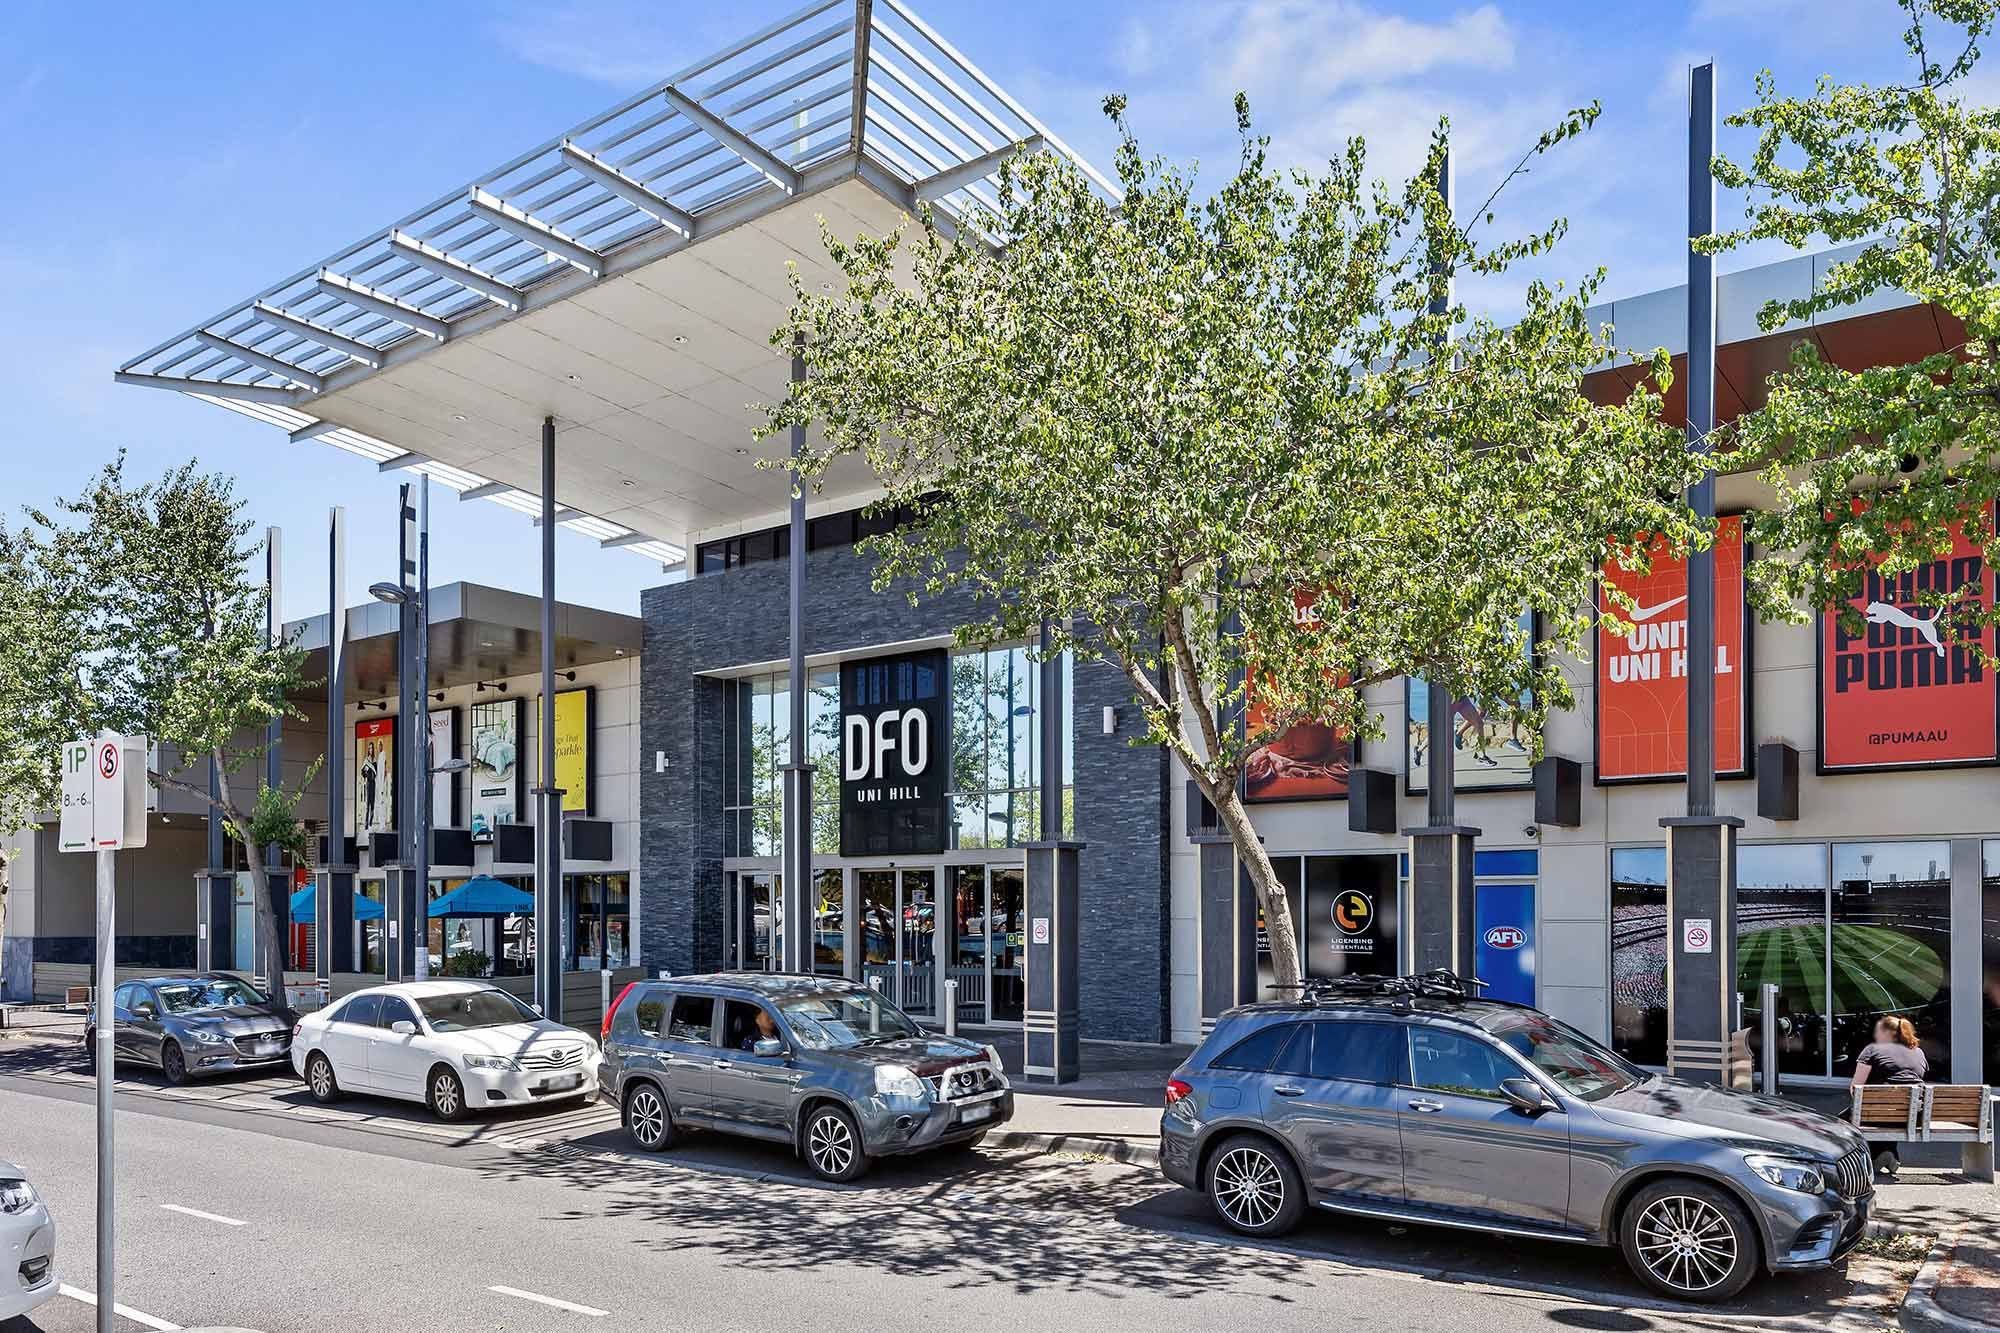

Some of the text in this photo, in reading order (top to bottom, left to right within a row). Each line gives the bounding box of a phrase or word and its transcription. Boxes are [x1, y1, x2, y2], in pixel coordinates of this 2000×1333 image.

[1609, 645, 1733, 684] UNI HL
[1836, 642, 1983, 694] PUMA
[555, 743, 582, 760] parkle
[845, 707, 927, 781] DFO
[67, 746, 87, 773] 1P
[857, 785, 921, 802] UNI HILL
[1488, 931, 1523, 944] AFL
